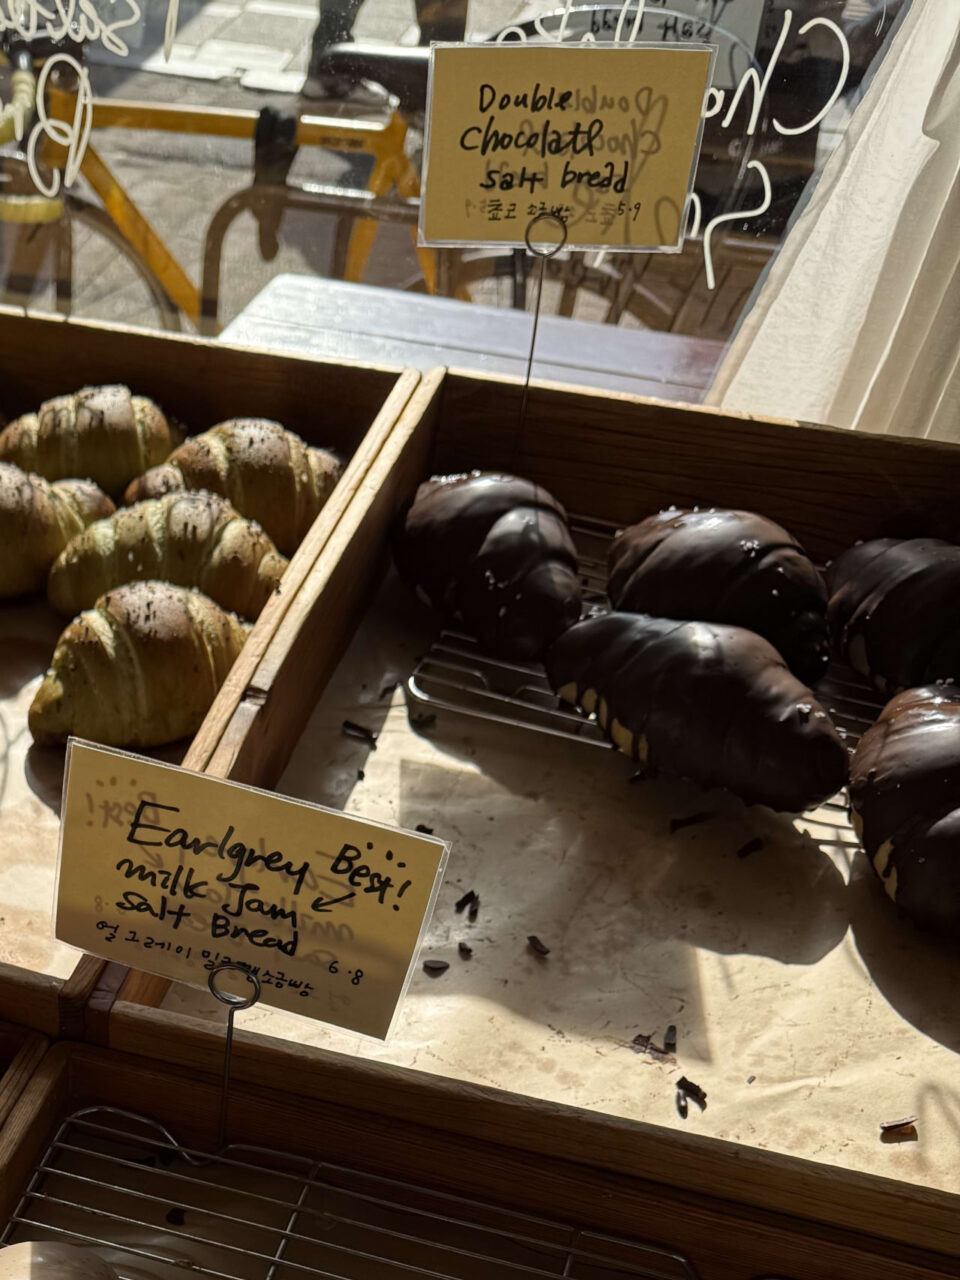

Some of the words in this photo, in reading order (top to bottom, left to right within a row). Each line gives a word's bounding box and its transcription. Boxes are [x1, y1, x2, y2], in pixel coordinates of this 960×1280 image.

[479, 83, 573, 113] Double
[480, 166, 544, 194] salt
[560, 161, 628, 194] bread
[116, 858, 210, 898] milk
[222, 883, 298, 929] Jam
[212, 914, 299, 957] Bread
[328, 960, 365, 985] 6.8
